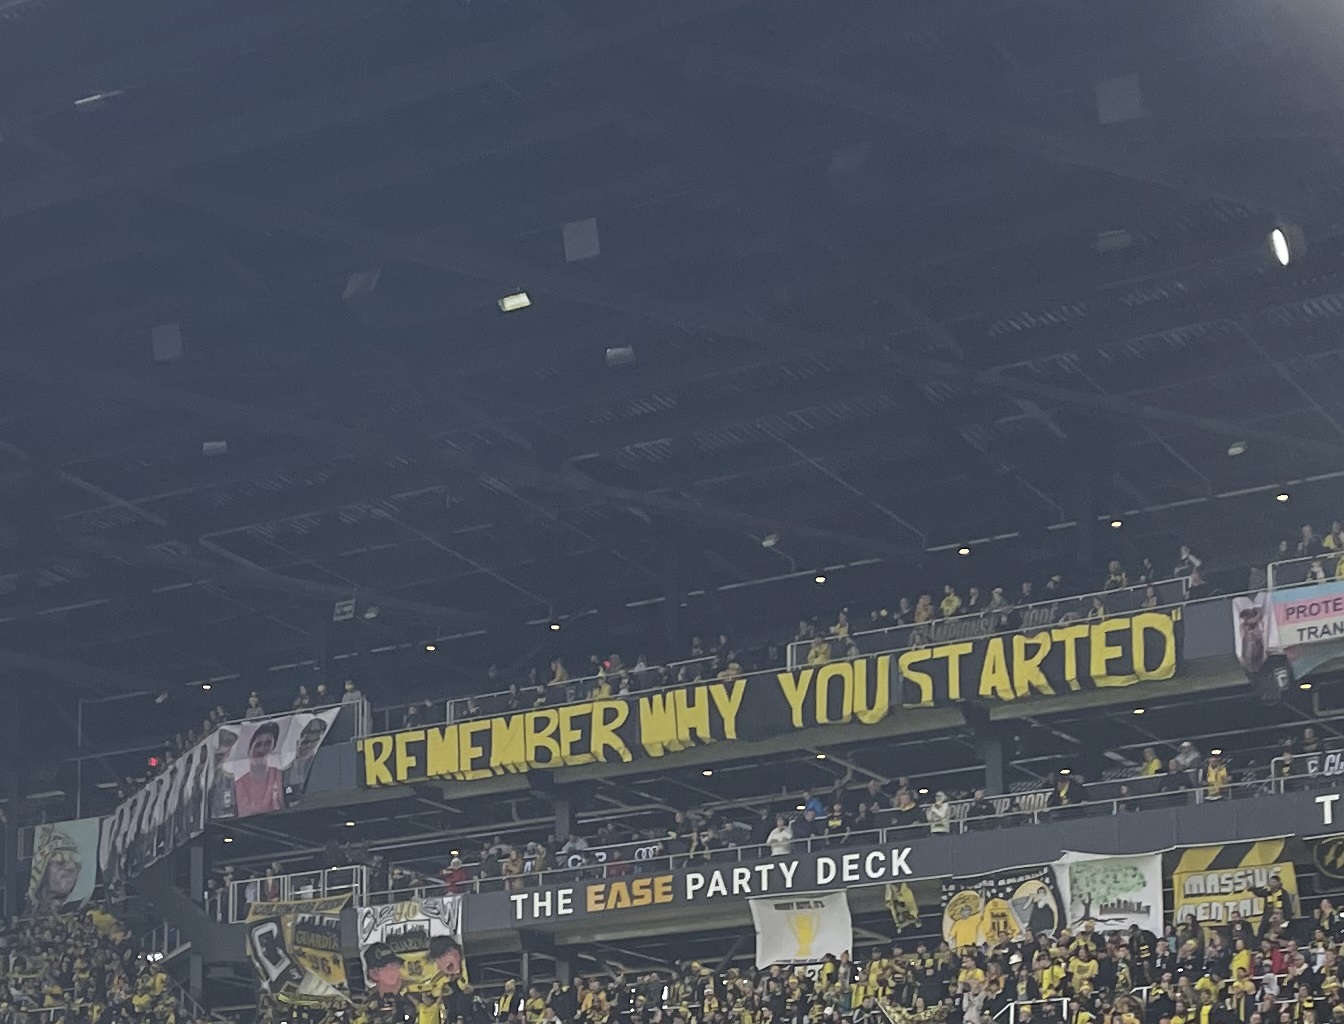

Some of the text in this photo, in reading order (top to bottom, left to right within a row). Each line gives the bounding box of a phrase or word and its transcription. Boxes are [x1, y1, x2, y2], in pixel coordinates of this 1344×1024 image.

[639, 678, 747, 757] WHY
[778, 654, 890, 728] YOU
[510, 846, 914, 920] THE EASE PARTY DECK
